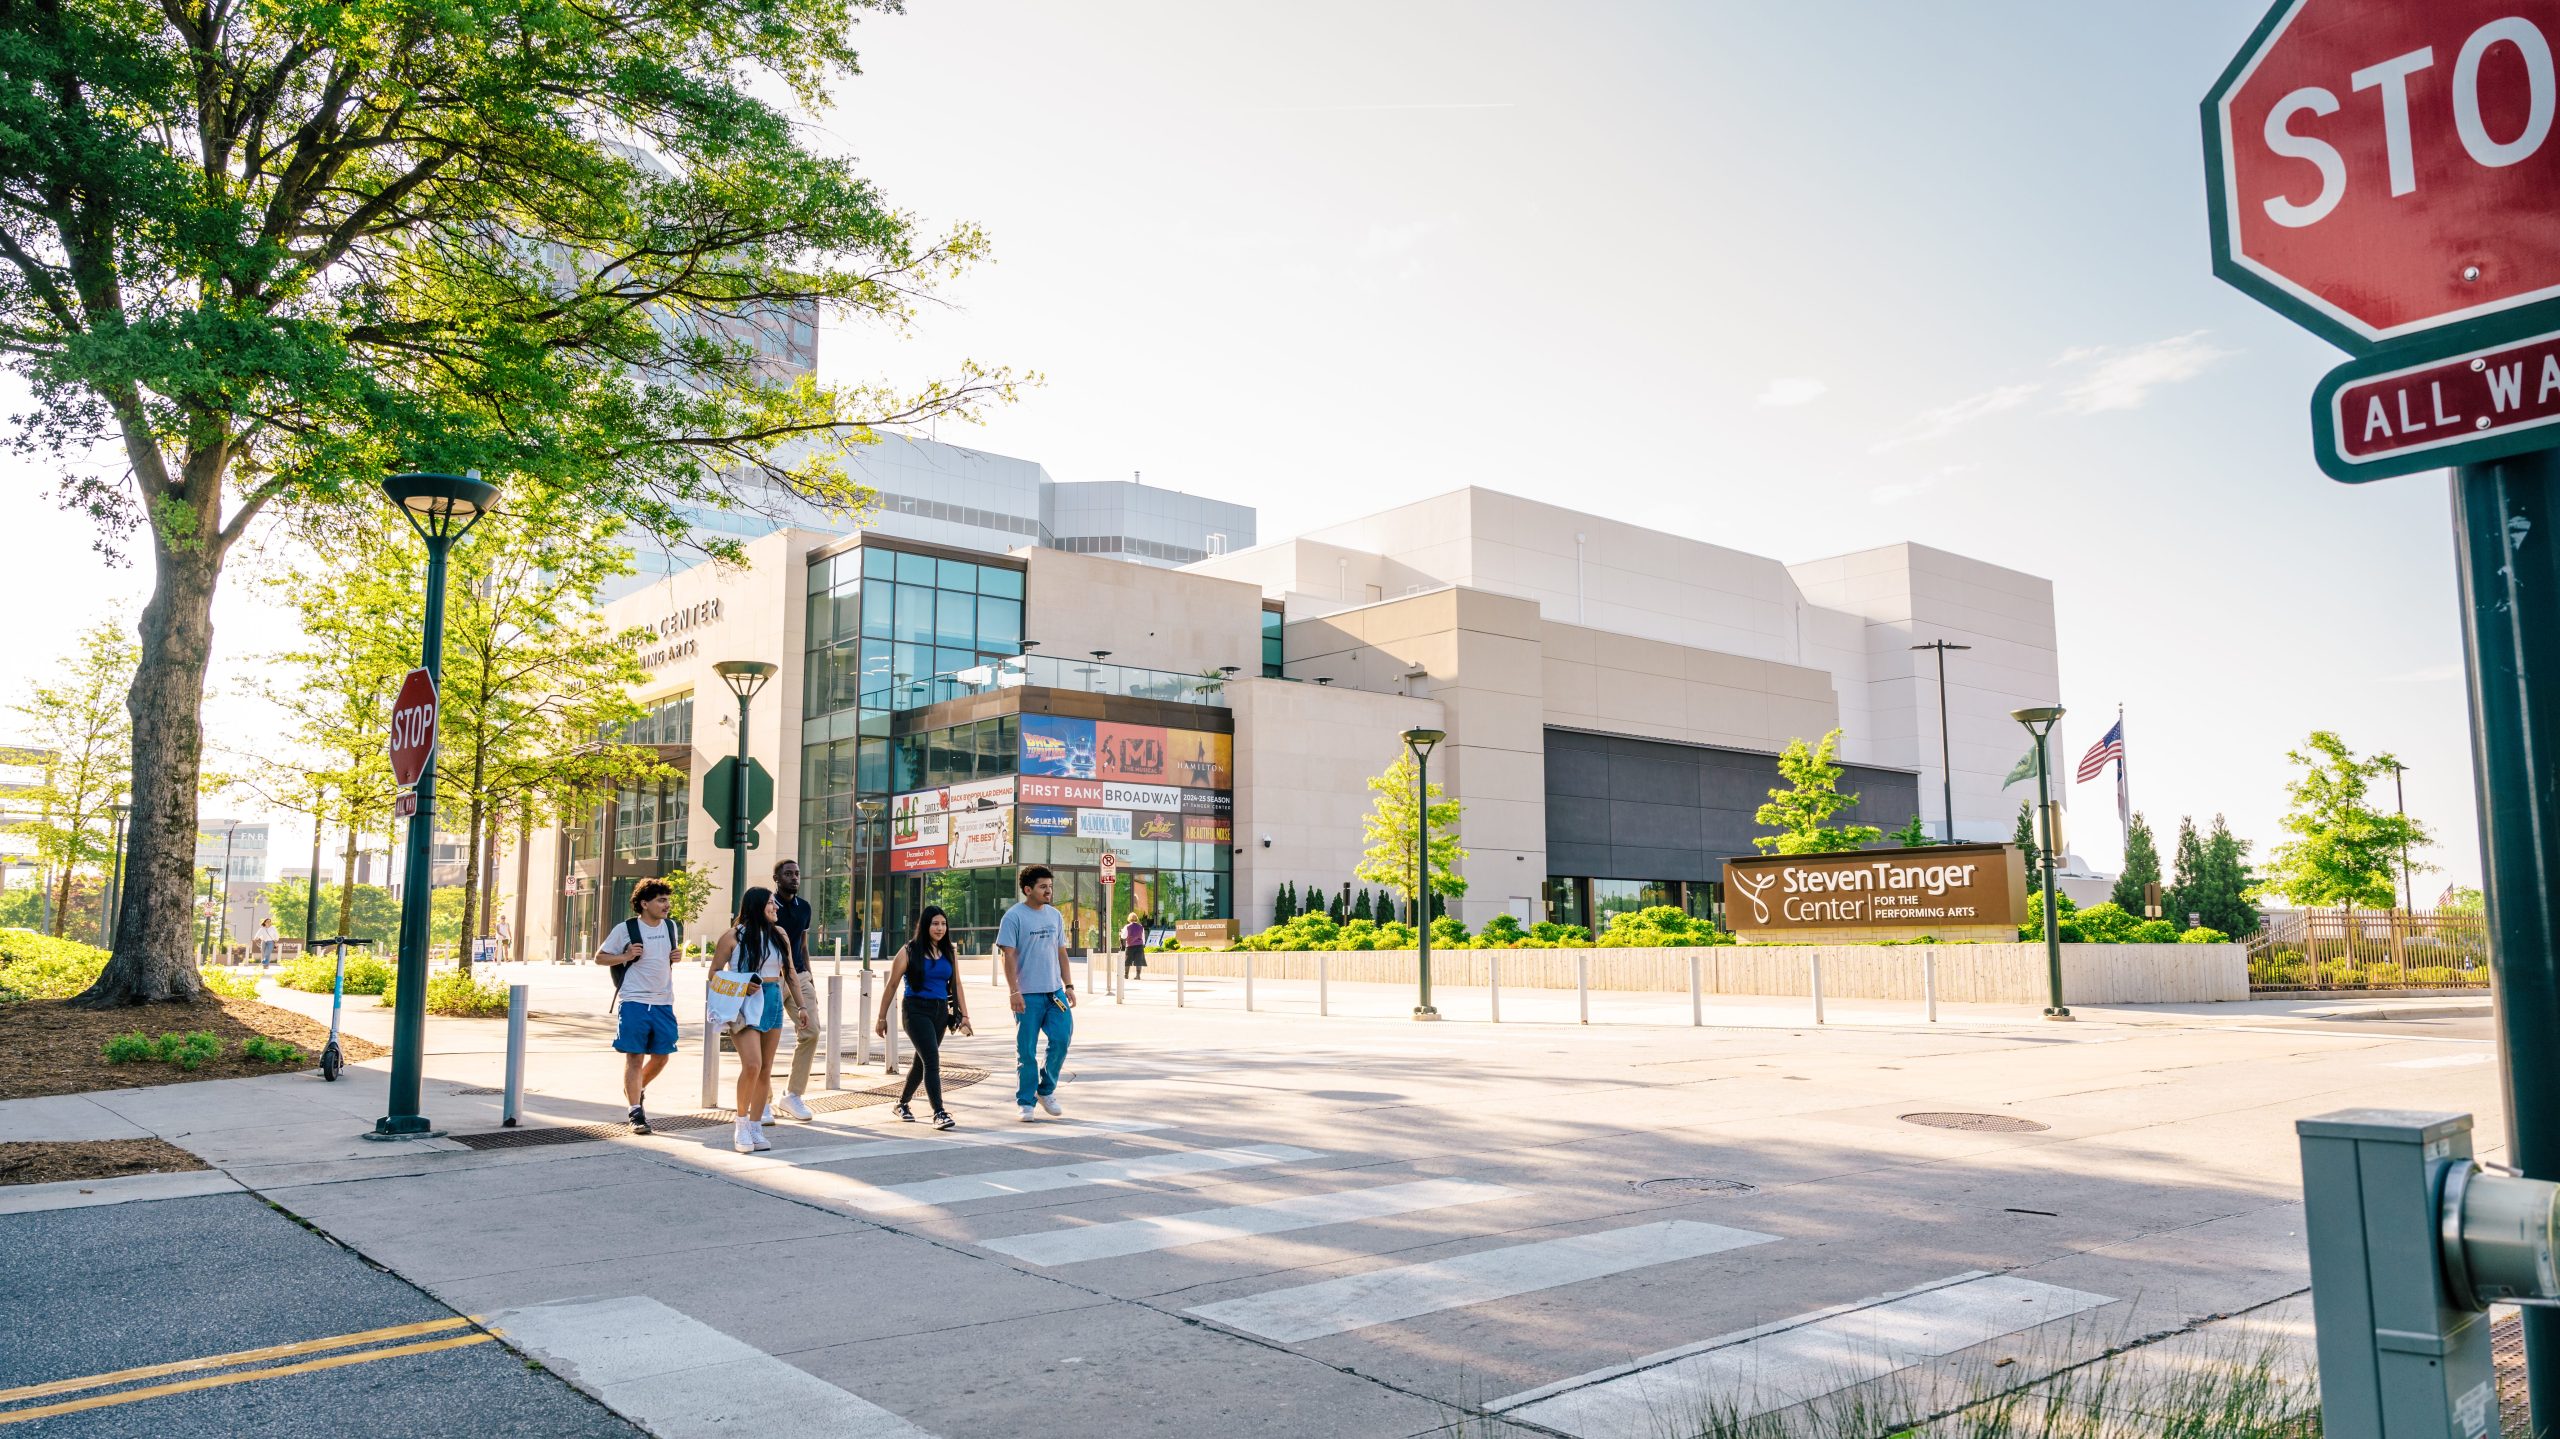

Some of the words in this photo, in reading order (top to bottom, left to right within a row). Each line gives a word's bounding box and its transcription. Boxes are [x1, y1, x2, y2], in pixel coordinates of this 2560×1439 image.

[2363, 381, 2461, 442] ALL
[660, 597, 720, 638] CENTER
[668, 639, 695, 660] ARTS
[393, 703, 433, 752] STOP
[1125, 739, 1158, 767] MJ
[1177, 762, 1224, 773] HAMILTON
[970, 790, 992, 799] POPULAR
[992, 787, 1013, 796] DEMAND
[1022, 784, 1059, 797] FIRST
[1065, 786, 1101, 799] BANK
[1105, 789, 1178, 805] BROADWAY
[1206, 796, 1230, 804] SEASON
[985, 821, 1004, 829] MORMN
[1058, 817, 1074, 826] HOT
[924, 825, 940, 835] MUSICAL
[1215, 827, 1231, 841] NOISE
[968, 835, 980, 843] THE
[981, 832, 996, 842] BEST
[1874, 896, 1896, 906] FOR
[1898, 895, 1919, 905] THE
[1783, 897, 1865, 921] Center
[1875, 908, 1945, 918] PERFORMING
[1948, 906, 1975, 917] ARTS
